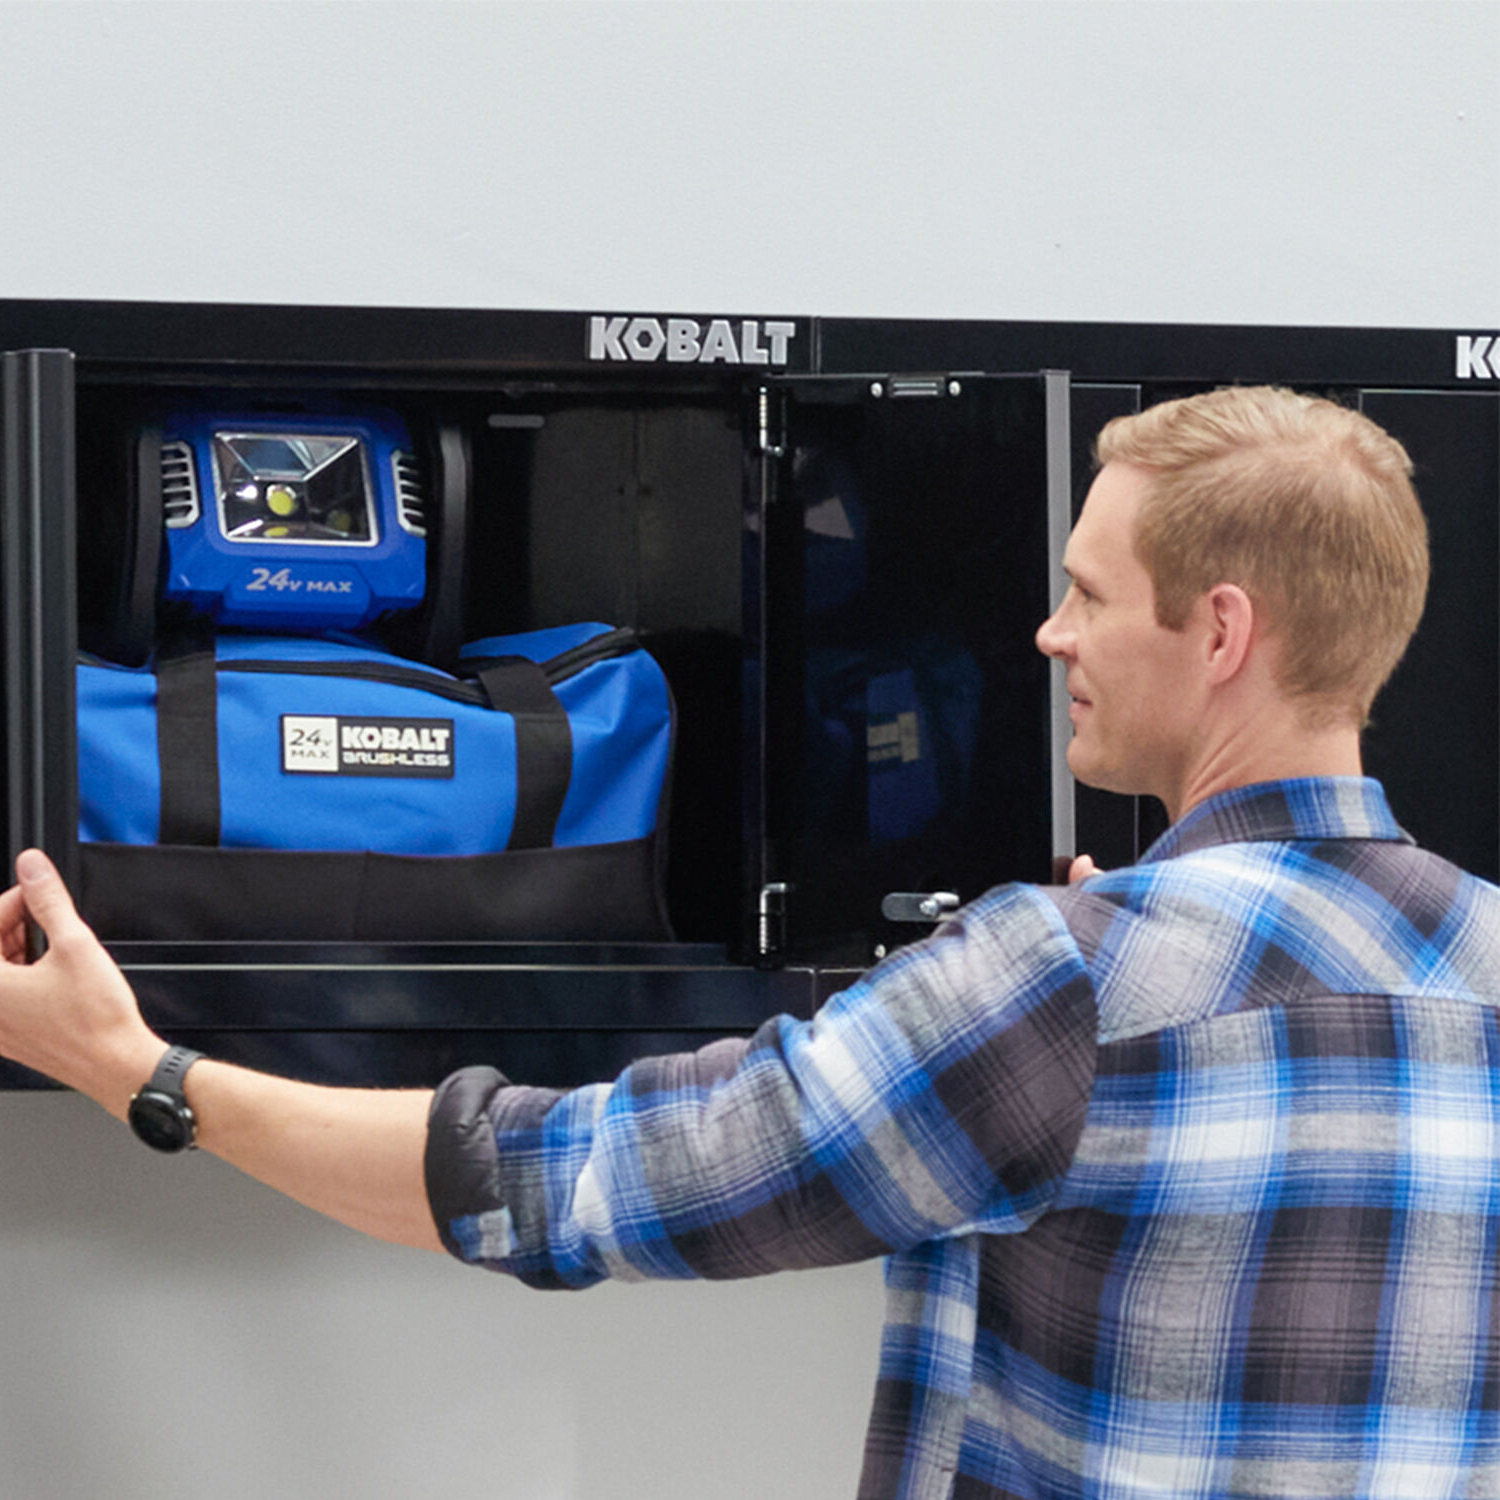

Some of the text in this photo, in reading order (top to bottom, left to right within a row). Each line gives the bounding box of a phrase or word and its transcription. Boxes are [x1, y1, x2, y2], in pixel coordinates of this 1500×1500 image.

[589, 316, 796, 365] KOBALT
[1455, 335, 1500, 379] K
[306, 580, 353, 593] MAX
[341, 726, 450, 751] KOBALT
[290, 750, 331, 759] MAX
[342, 751, 451, 767] BRUSHLESS
